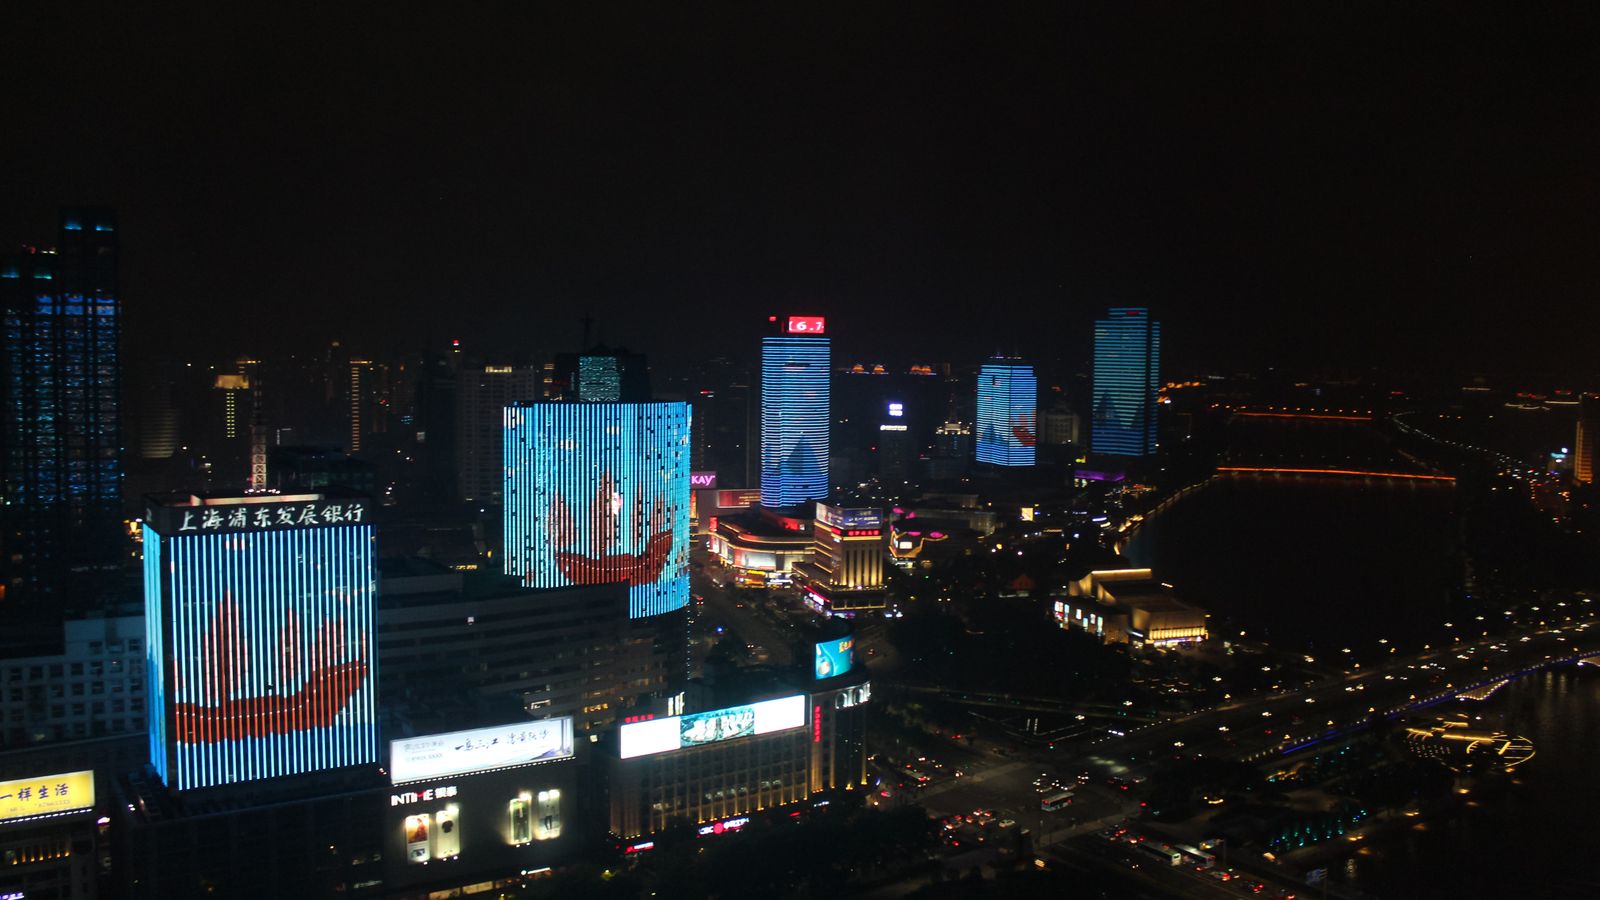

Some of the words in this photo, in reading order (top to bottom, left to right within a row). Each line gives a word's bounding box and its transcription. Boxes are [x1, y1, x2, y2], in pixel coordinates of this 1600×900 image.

[179, 503, 365, 532] 上海浦东发展银行
